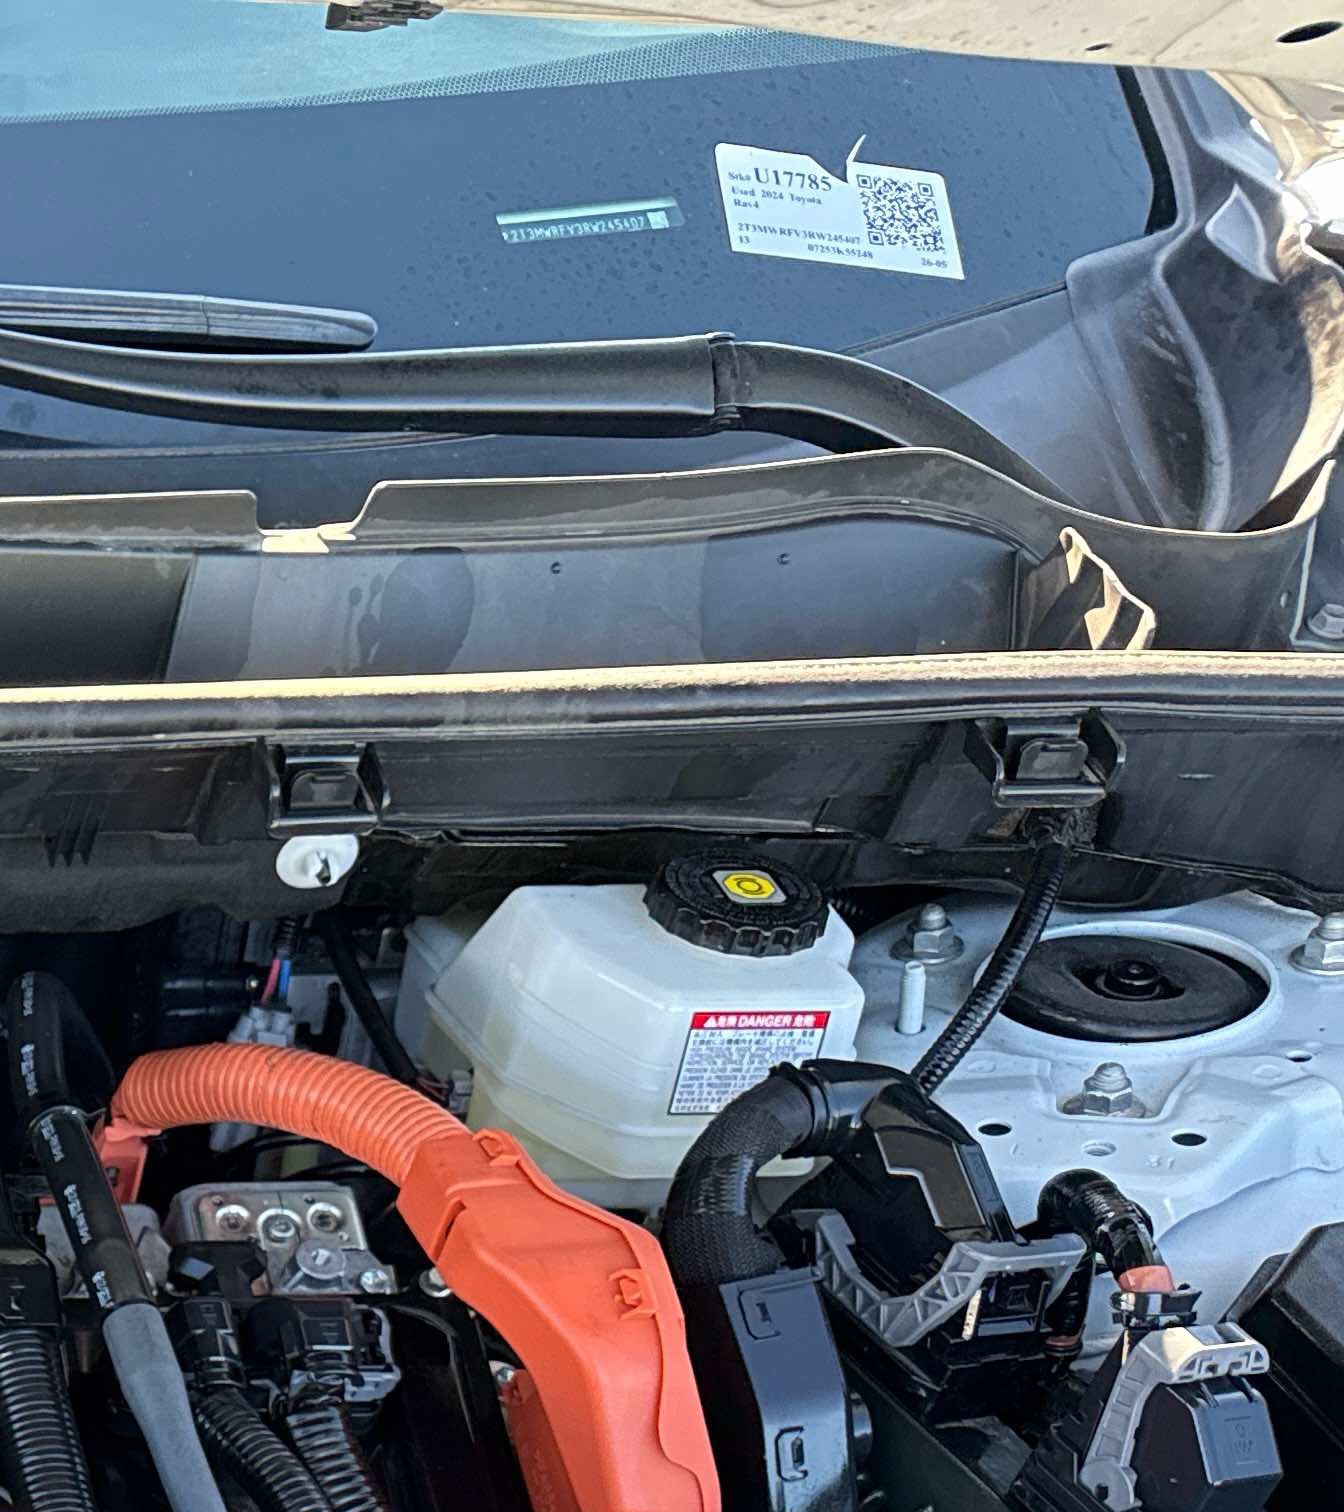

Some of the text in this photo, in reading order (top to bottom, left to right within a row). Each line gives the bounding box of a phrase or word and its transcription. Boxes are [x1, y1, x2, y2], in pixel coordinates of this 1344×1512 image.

[754, 167, 832, 192] U17785
[732, 186, 755, 197] Used
[761, 189, 784, 200] 2024
[733, 198, 759, 209] Rav4
[738, 1014, 792, 1028] DANGER
